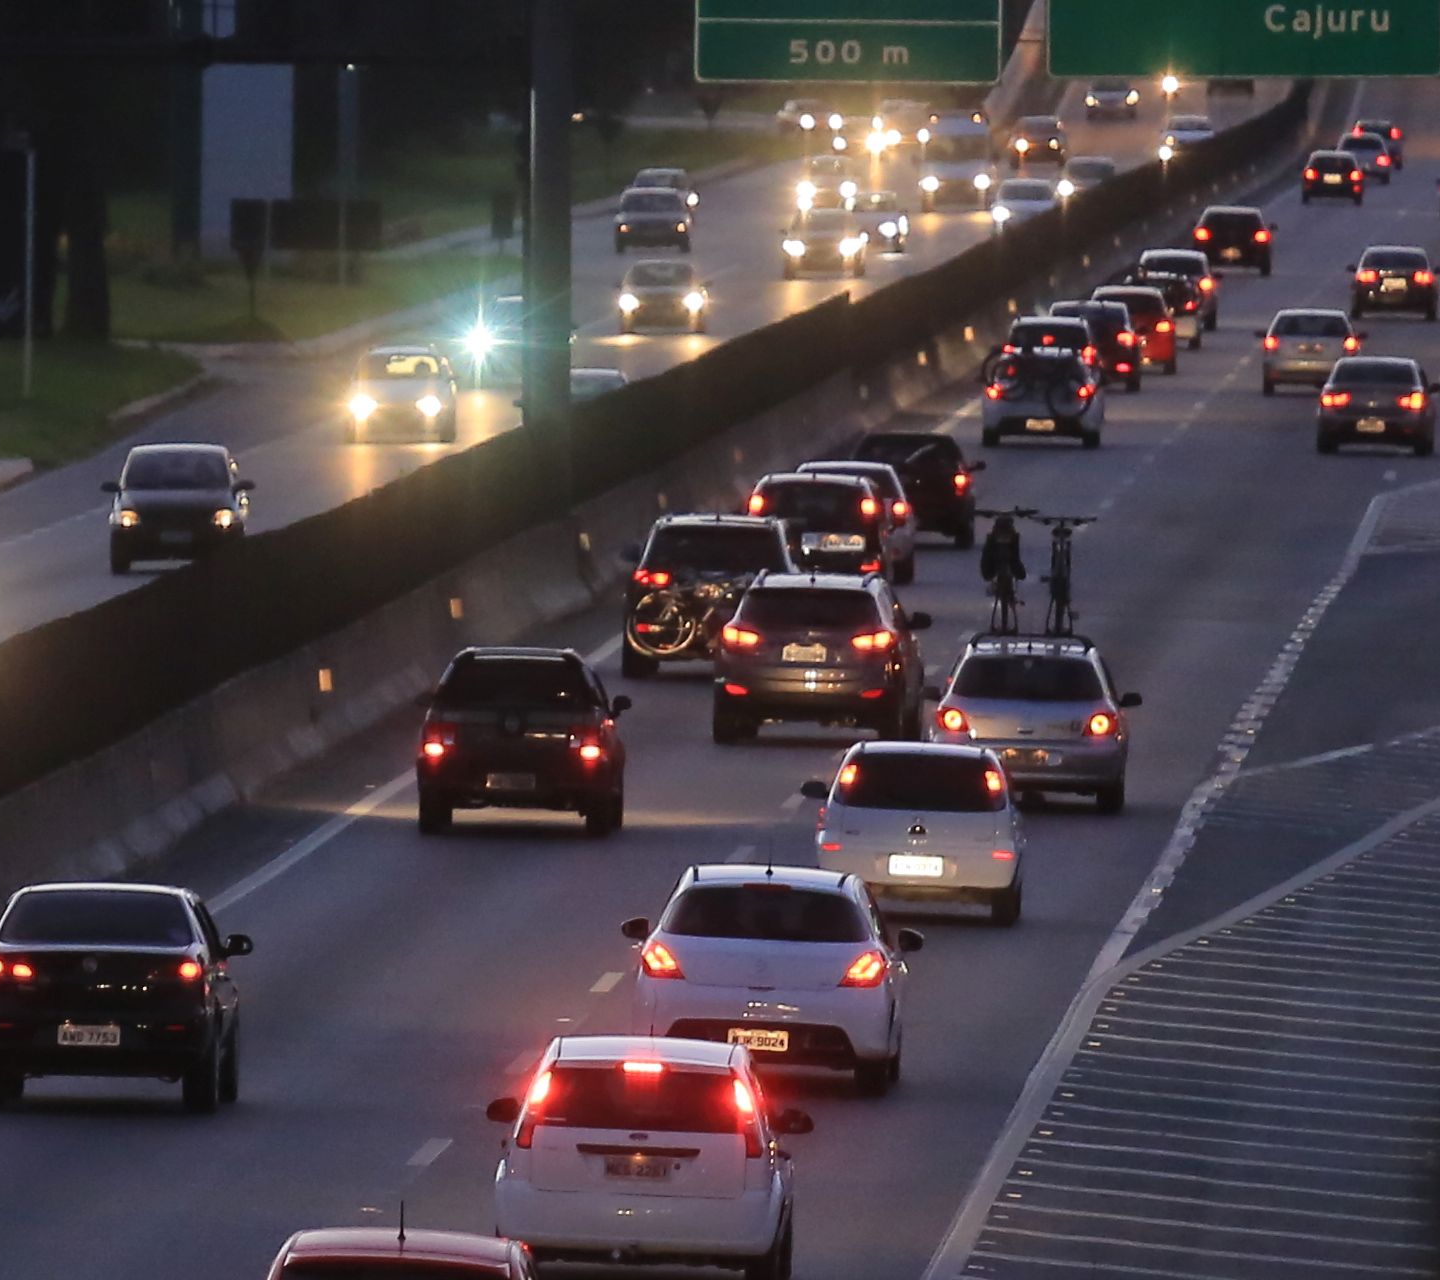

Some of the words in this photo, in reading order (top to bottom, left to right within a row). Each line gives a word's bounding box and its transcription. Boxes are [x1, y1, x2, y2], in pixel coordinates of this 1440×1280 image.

[1263, 3, 1391, 40] Cajuru
[788, 39, 863, 65] 500
[882, 44, 909, 65] m
